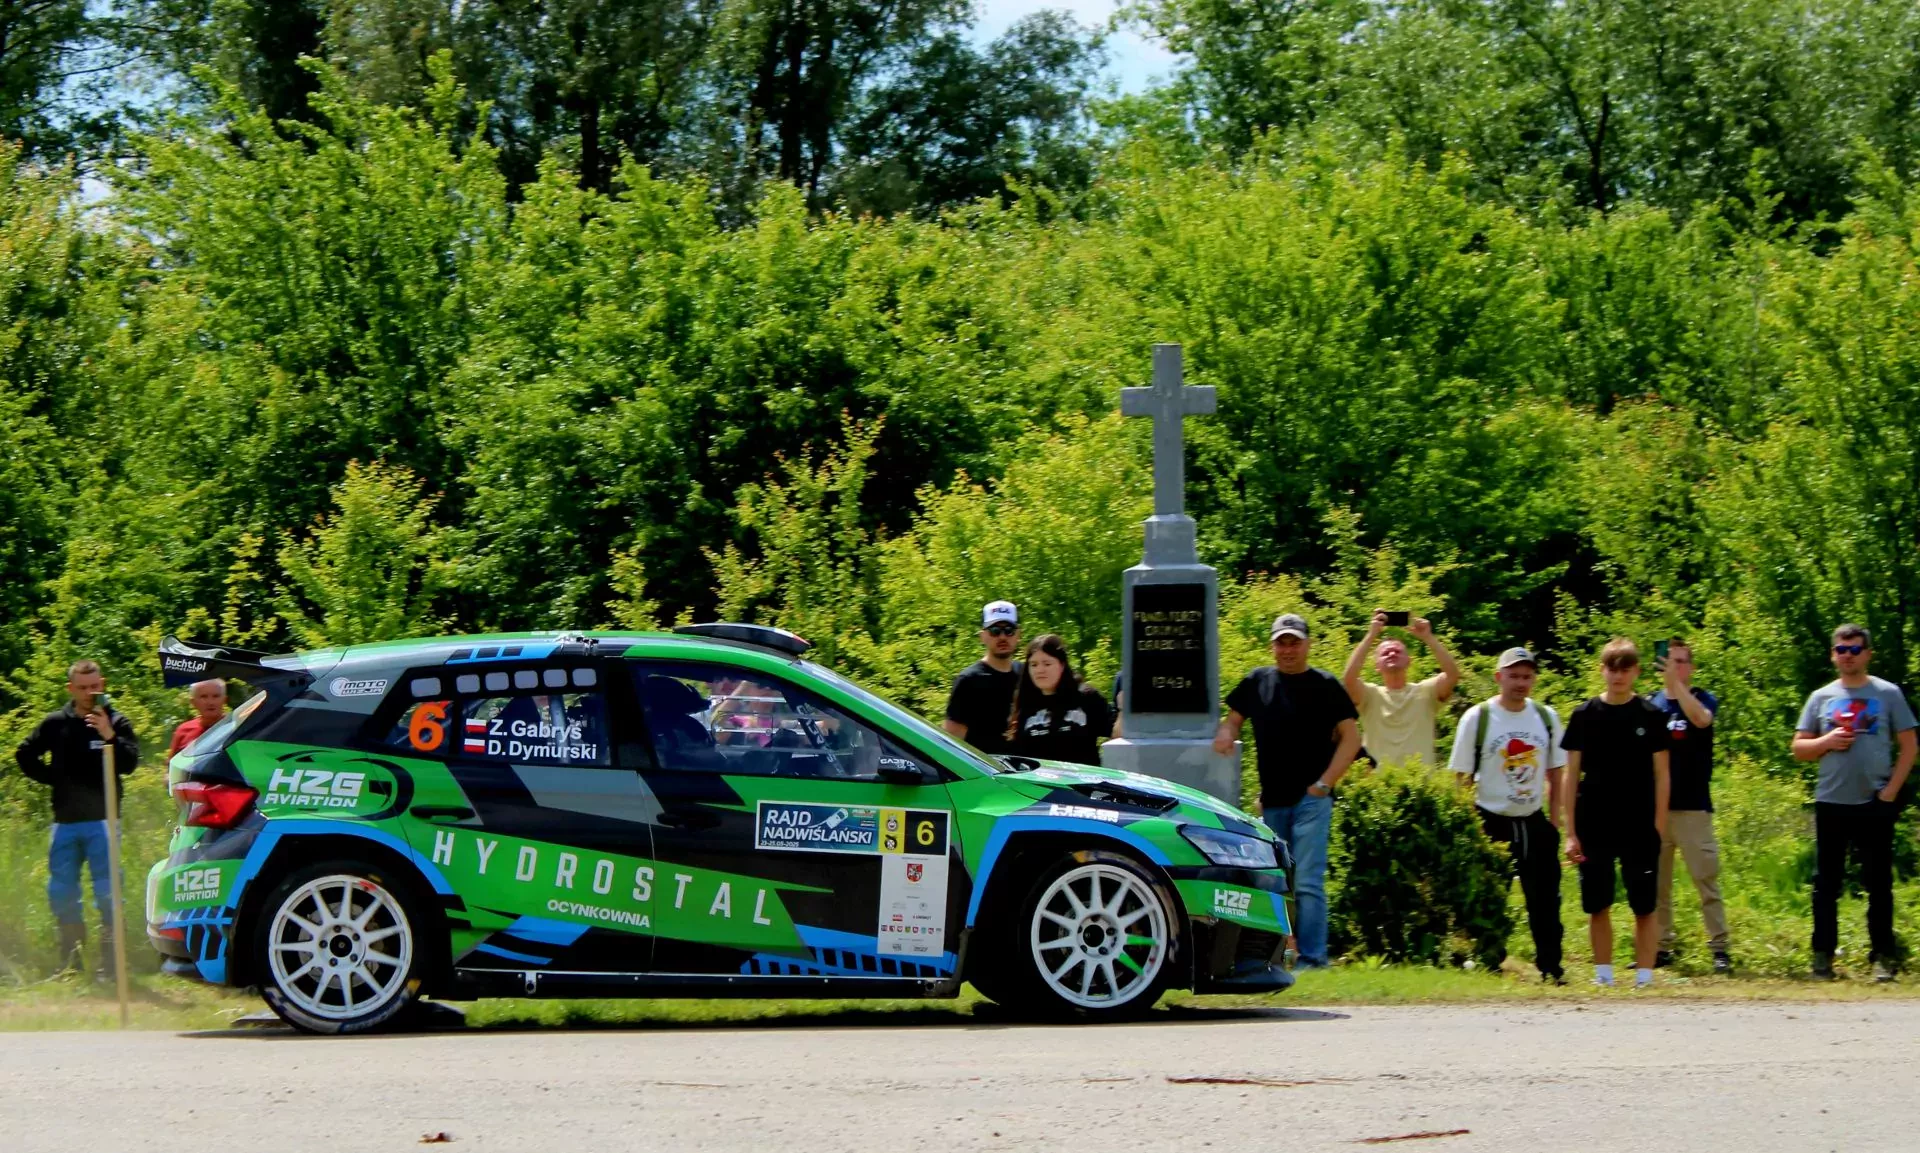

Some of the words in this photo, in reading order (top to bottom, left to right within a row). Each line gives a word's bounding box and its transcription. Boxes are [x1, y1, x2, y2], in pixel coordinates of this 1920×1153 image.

[166, 657, 207, 671] buchti.pl
[344, 681, 386, 689] MOTO
[408, 702, 446, 752] 6
[489, 719, 508, 736] Z.
[487, 740, 506, 756] D.
[508, 741, 597, 760] Dymurski
[267, 768, 366, 796] HZG
[264, 792, 358, 808] AVIATION
[766, 809, 812, 827] RAJD
[763, 826, 873, 844] NADWIŚLAŃSKI
[916, 820, 935, 846] 6
[174, 867, 221, 892] HZG
[432, 830, 771, 926] HYDROSTAL
[174, 889, 219, 902] AVIATION
[1214, 888, 1252, 910] HZG
[546, 899, 651, 928] OCYNKOWNIA
[1214, 905, 1249, 917] AVIATION
